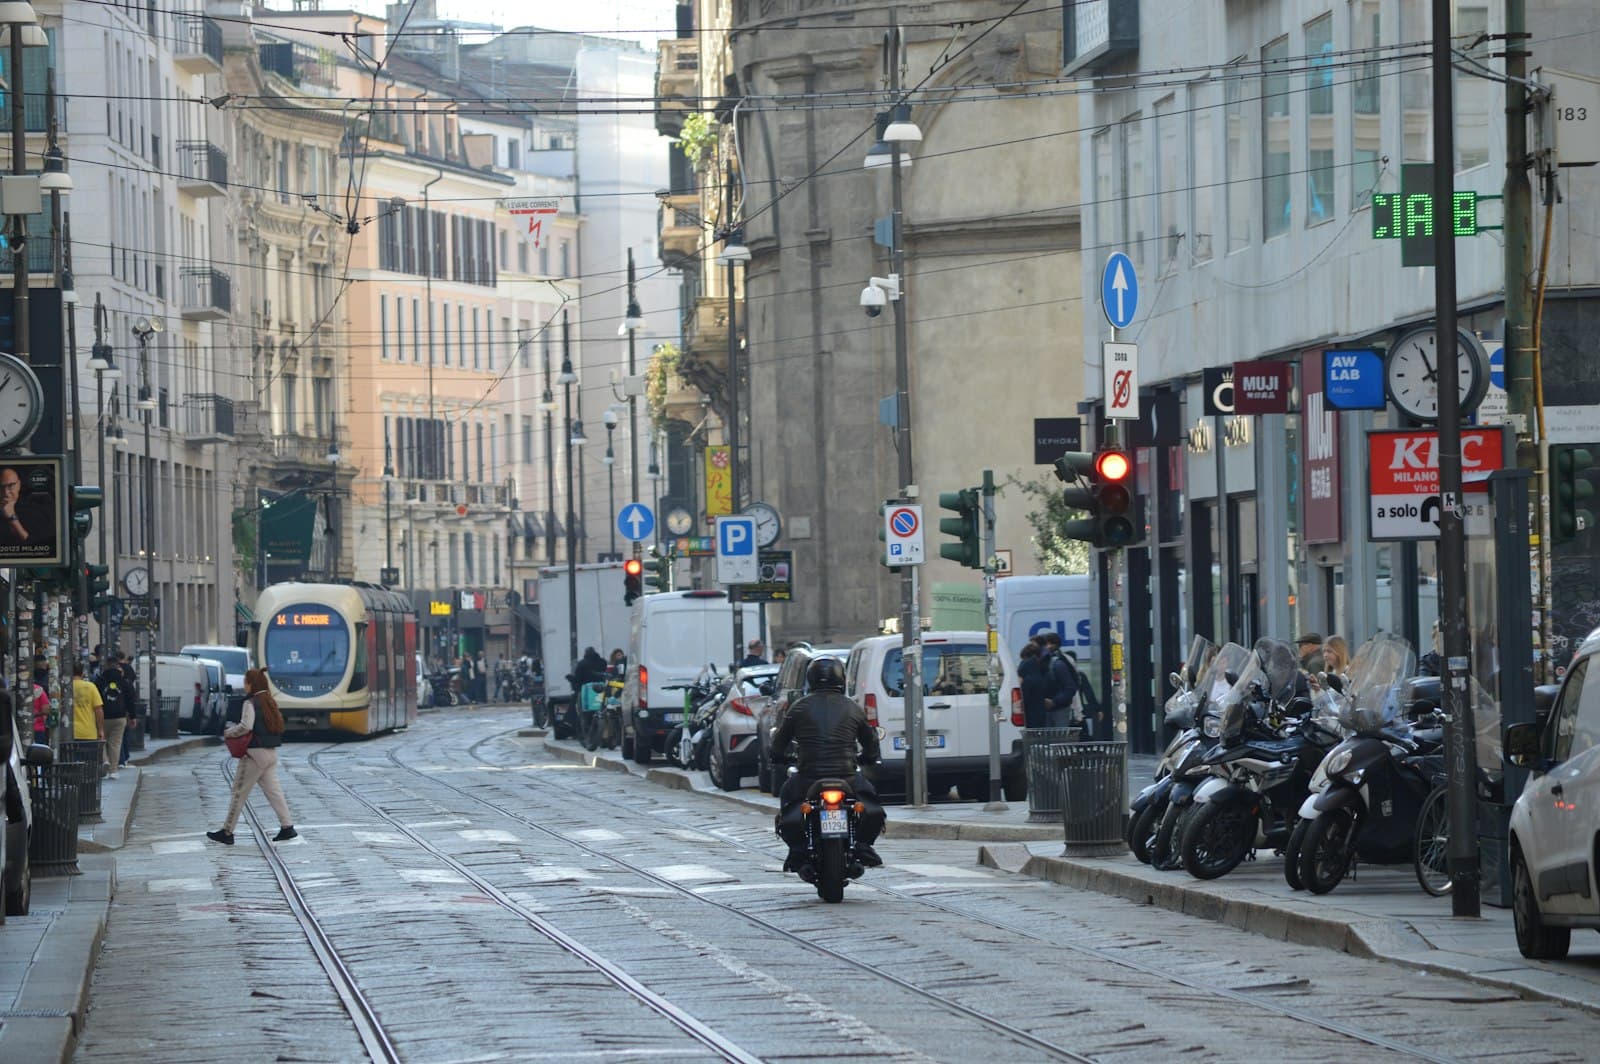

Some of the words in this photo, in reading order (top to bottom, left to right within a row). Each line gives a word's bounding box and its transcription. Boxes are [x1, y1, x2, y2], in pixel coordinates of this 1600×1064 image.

[1557, 108, 1587, 120] 183
[1332, 356, 1357, 368] AW
[1331, 369, 1361, 381] LAB
[1242, 376, 1279, 391] MUJI
[1037, 438, 1078, 446] SEPHORA
[1393, 471, 1438, 483] MILANO
[1414, 484, 1428, 492] Via
[1377, 508, 1385, 518] a
[1389, 504, 1418, 518] solo
[726, 525, 746, 552] P
[277, 614, 286, 625] 14
